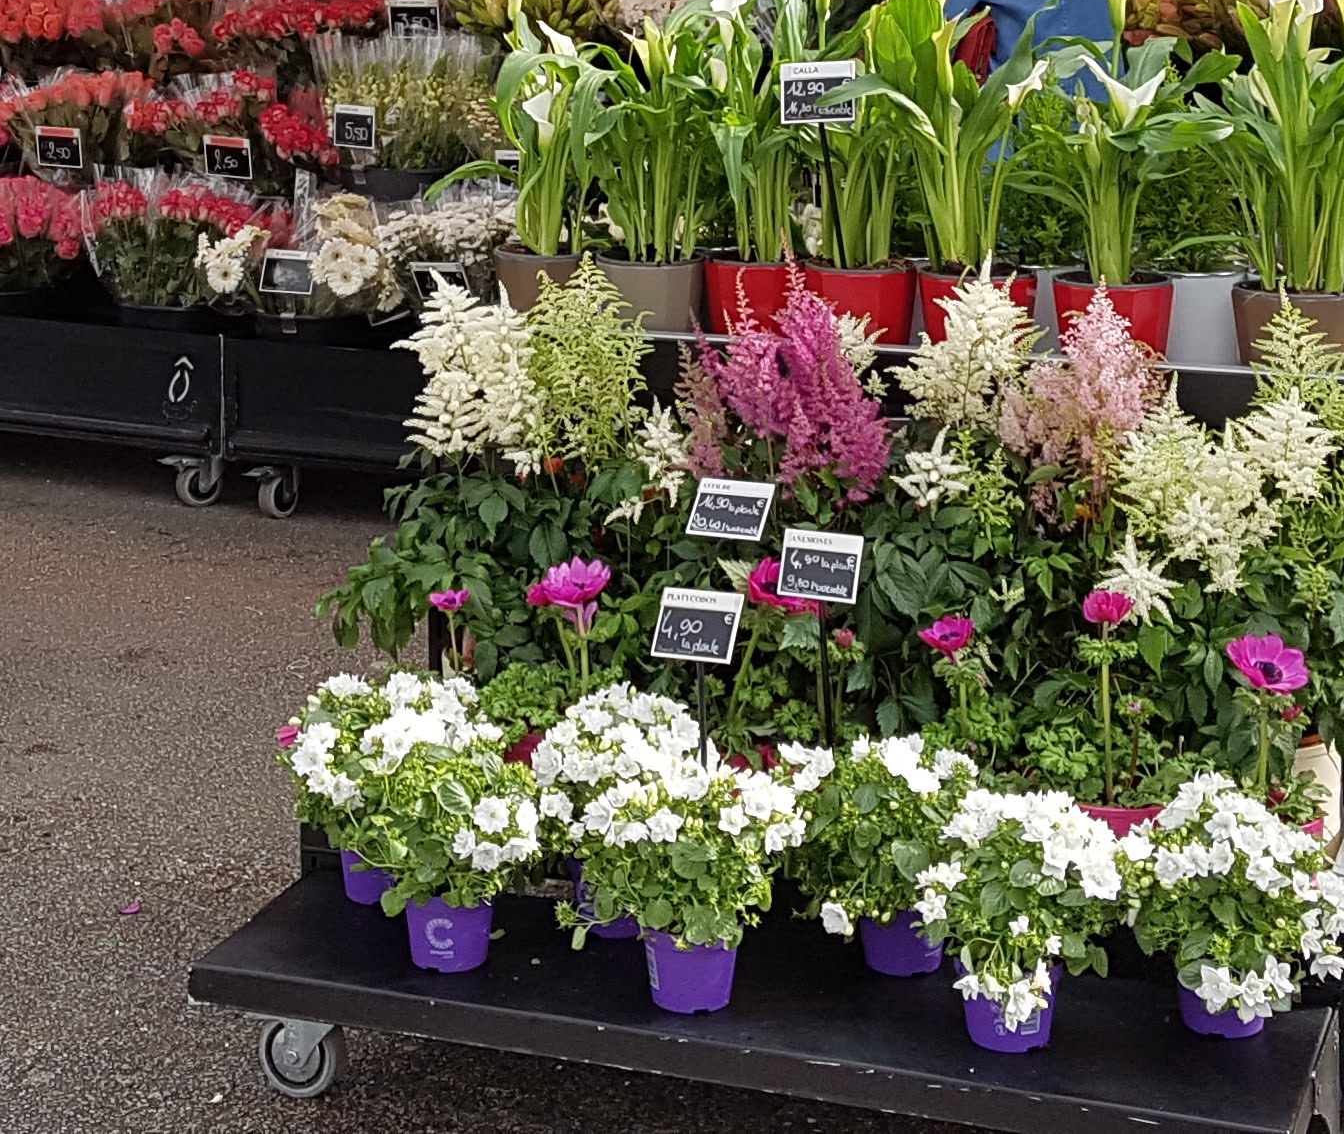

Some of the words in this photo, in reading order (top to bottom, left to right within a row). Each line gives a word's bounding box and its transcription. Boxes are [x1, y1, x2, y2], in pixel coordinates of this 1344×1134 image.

[793, 66, 819, 74] CALLA
[703, 482, 732, 491] ASTILBE
[791, 534, 833, 545] ANEMONES
[661, 609, 703, 641] 4,90
[682, 637, 691, 650] la
[691, 637, 719, 655] plante
